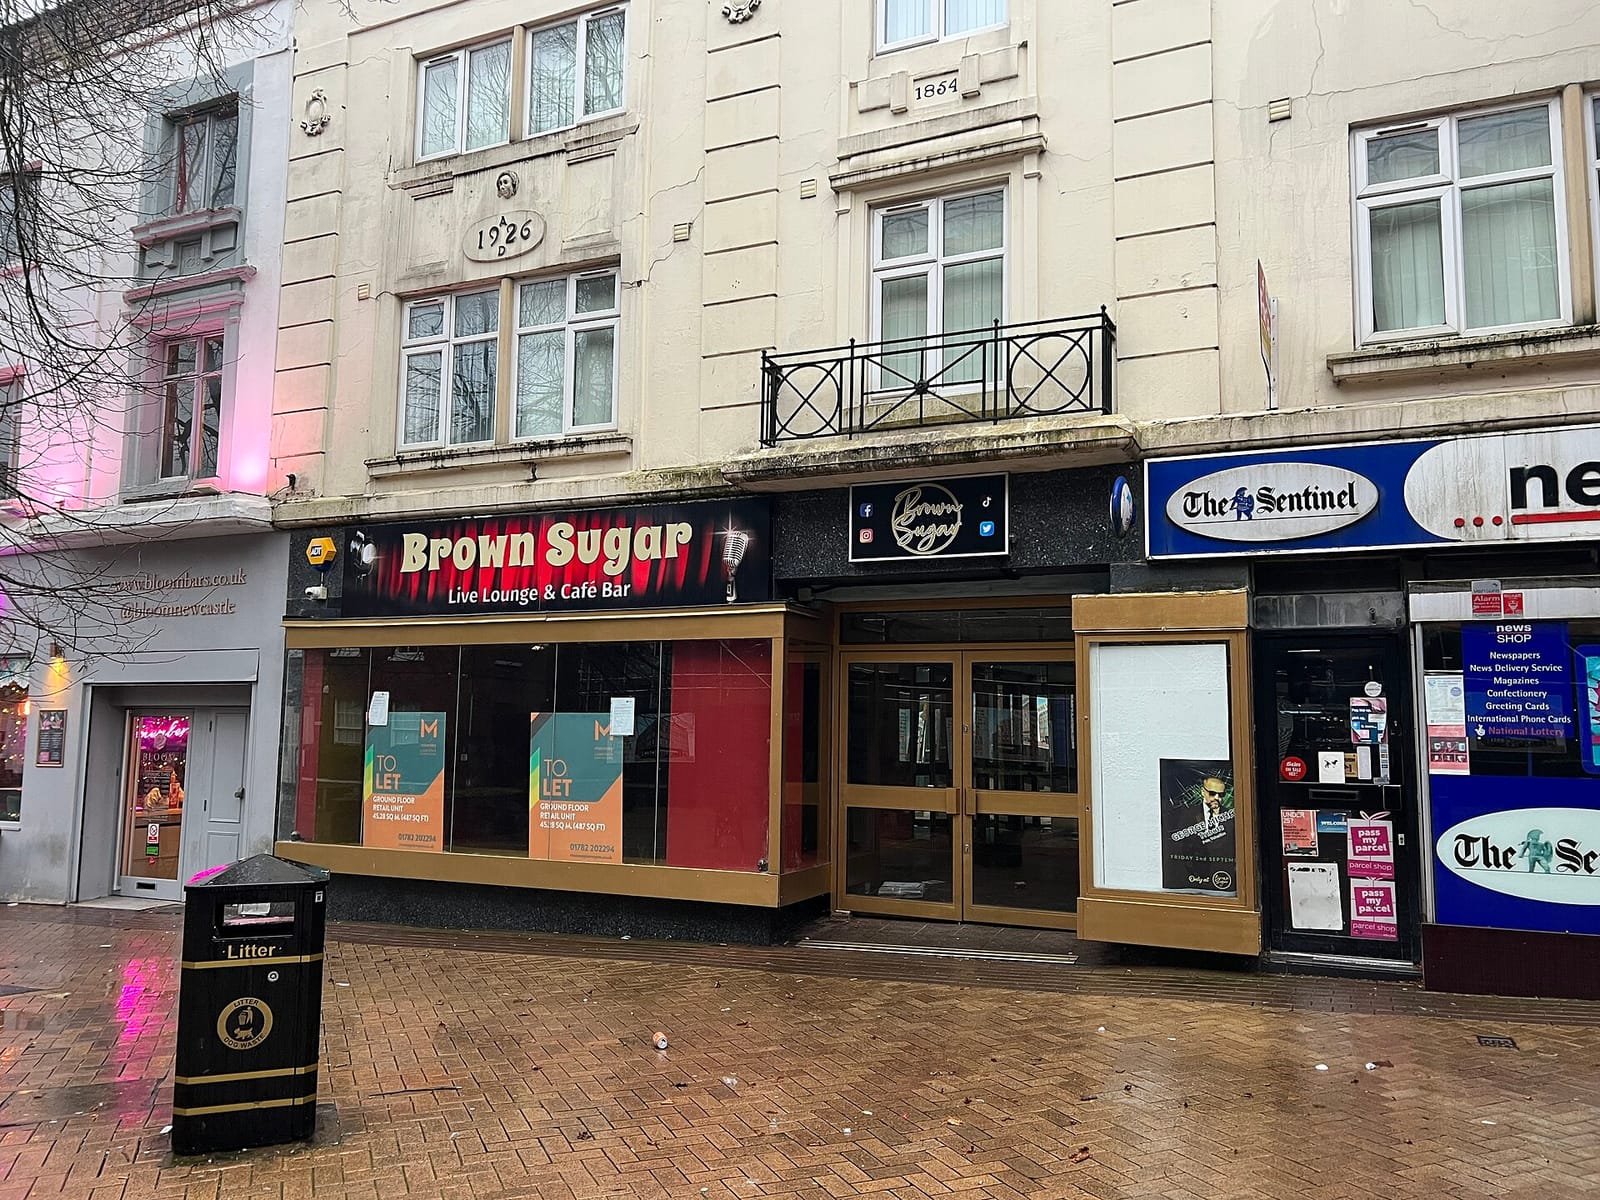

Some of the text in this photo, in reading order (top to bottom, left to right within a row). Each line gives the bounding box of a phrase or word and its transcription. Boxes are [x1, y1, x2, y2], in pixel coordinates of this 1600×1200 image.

[914, 77, 958, 100] 1854
[478, 219, 532, 250] 1926
[1509, 461, 1600, 510] ne
[1183, 480, 1359, 519] The Sentinel
[894, 486, 964, 526] Brown
[893, 522, 963, 551] Sugar
[399, 521, 693, 577] Brown Sugar
[448, 580, 632, 606] Live Lounge & Café Bar
[1495, 624, 1532, 632] news
[1496, 634, 1532, 643] SHOP
[1489, 651, 1541, 661] Newspapers
[1469, 663, 1563, 673] News Delivery Service
[1493, 676, 1540, 686] Magazines
[1486, 689, 1548, 699] Confectionery
[1485, 701, 1550, 711] Greeting Cards
[1467, 714, 1572, 723] International Phone Cards
[420, 718, 439, 738] M
[1487, 726, 1565, 737] National Lottery
[376, 754, 397, 772] TO
[543, 758, 568, 777] TO
[375, 773, 401, 791] LET
[543, 778, 573, 797] LET
[372, 795, 415, 804] GROUND FLOOR
[539, 803, 589, 812] GROUND FLOOR
[386, 813, 394, 821] SQ
[412, 815, 420, 823] SQ
[540, 812, 576, 821] RETAIL UNIT
[555, 822, 564, 831] SQ
[586, 823, 595, 832] SQ
[596, 823, 606, 831] FT)
[398, 833, 414, 841] 01782
[1358, 829, 1381, 838] pass
[1362, 836, 1378, 845] my
[569, 843, 615, 853] 01782 202294
[1355, 843, 1387, 853] parcel
[1453, 833, 1600, 874] The Se
[1349, 862, 1393, 871] parcel shop
[1361, 890, 1385, 899] pass
[1366, 897, 1382, 906] my
[1358, 904, 1391, 914] parcel
[1352, 923, 1396, 932] parcel shop
[227, 943, 277, 959] Litter
[233, 999, 259, 1008] LITTER
[223, 1033, 266, 1048] DOG WASTE
